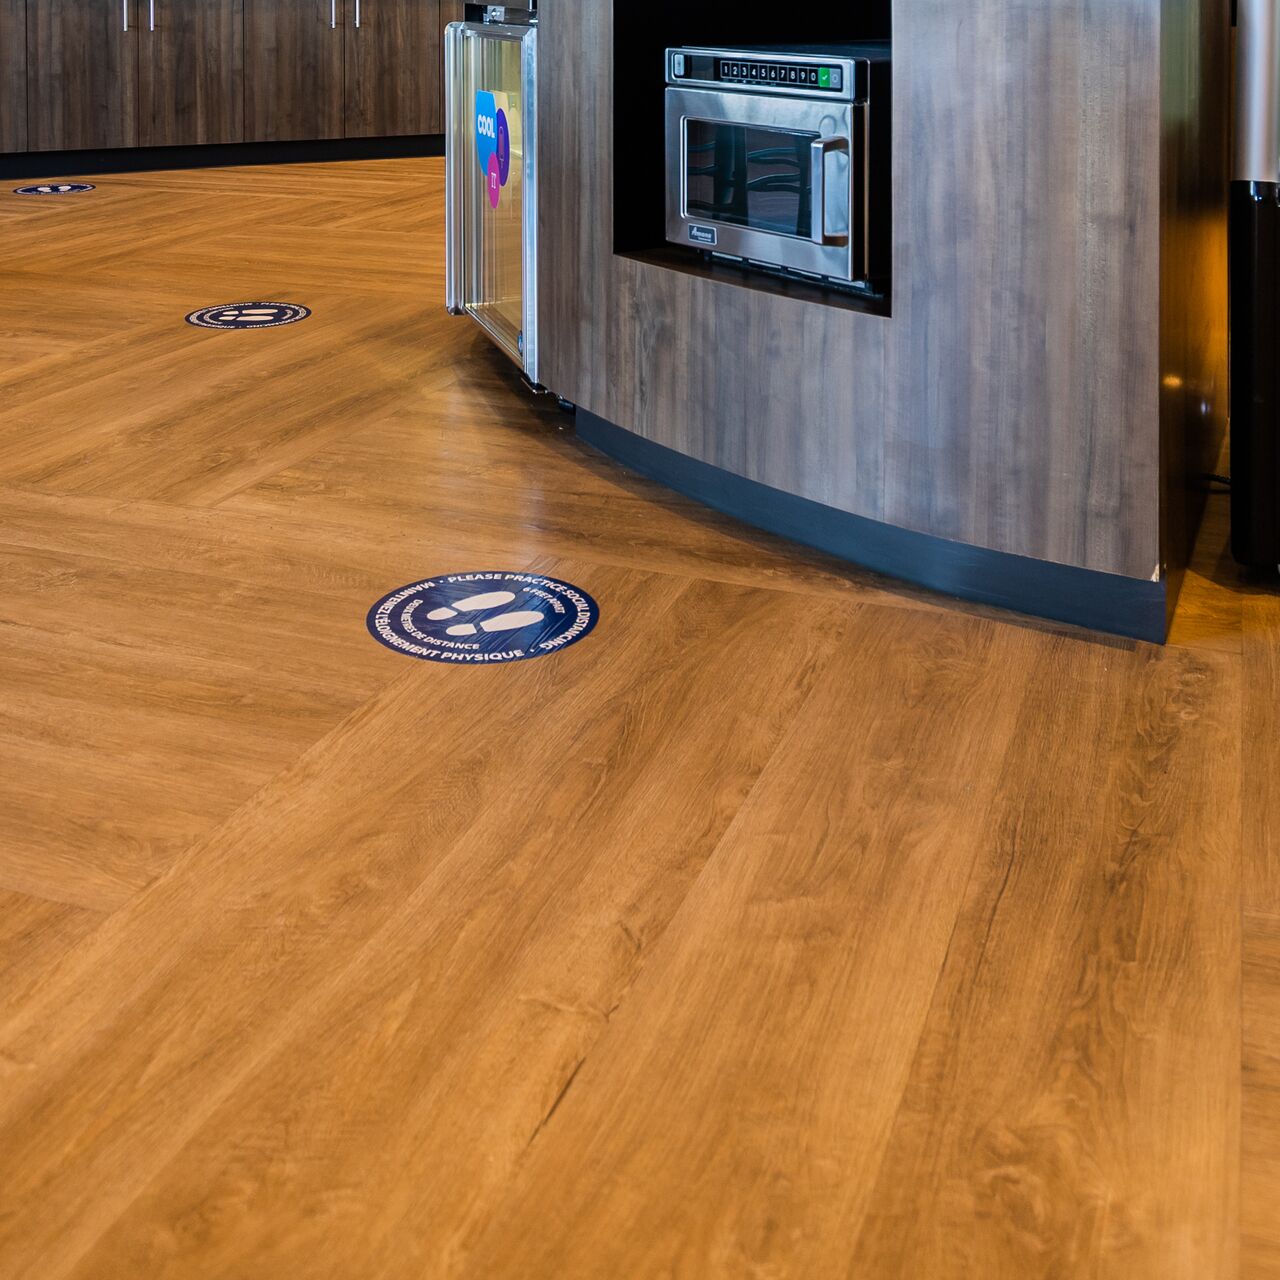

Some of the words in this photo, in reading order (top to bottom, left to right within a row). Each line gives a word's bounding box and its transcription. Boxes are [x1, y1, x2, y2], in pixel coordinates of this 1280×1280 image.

[478, 113, 495, 139] COOL
[447, 573, 502, 583] PLEASE
[504, 574, 568, 592] PRACTICE
[529, 588, 550, 599] FEET
[548, 596, 566, 614] APART
[562, 589, 590, 612] SOCIAL
[377, 581, 436, 614] MAINTENEZ
[441, 649, 525, 660] PHYSIQUE
[539, 611, 591, 650] DISTANCING
[411, 631, 427, 639] DE
[423, 636, 480, 650] DISTANCE
